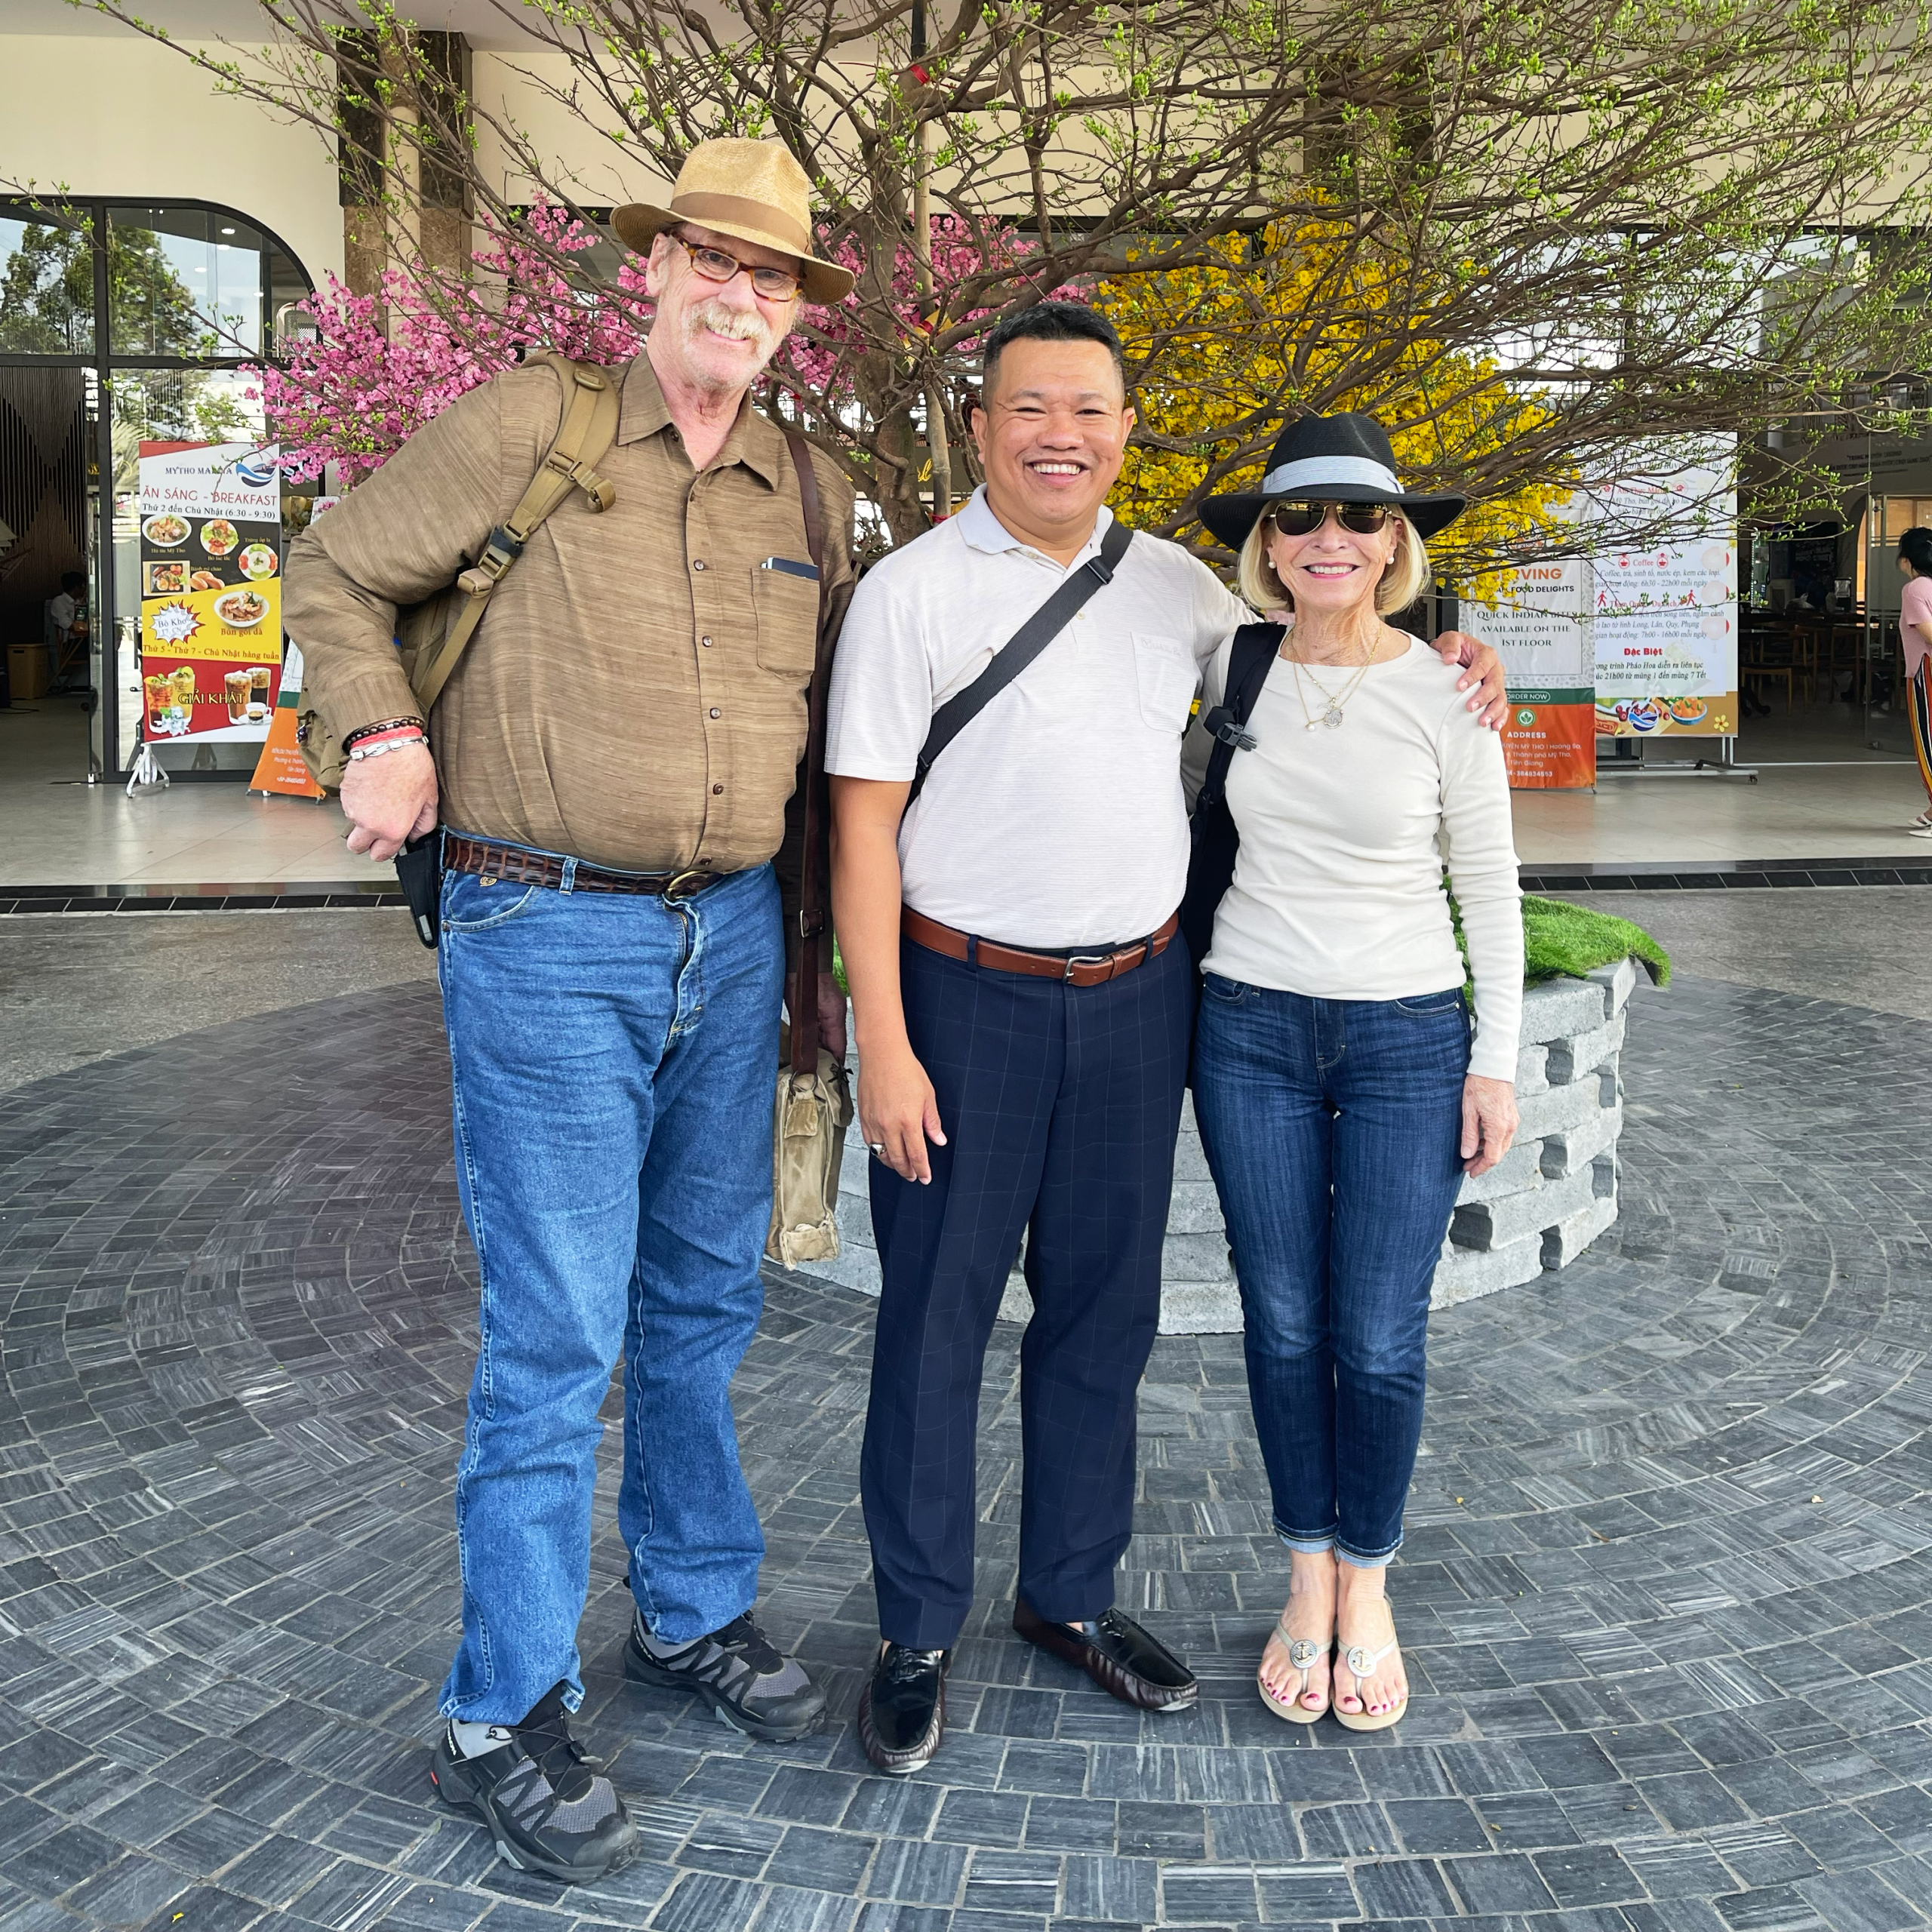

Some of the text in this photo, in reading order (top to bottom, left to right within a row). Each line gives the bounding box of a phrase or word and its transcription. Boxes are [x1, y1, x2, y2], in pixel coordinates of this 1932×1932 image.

[198, 466, 232, 475] MAA
[143, 485, 159, 498] ĂN
[165, 487, 198, 501] SÁNG
[214, 491, 277, 506] BREAKFAST
[143, 503, 158, 512] Thứ
[168, 503, 183, 513] đến
[186, 506, 202, 514] Chủ
[204, 507, 223, 517] Nhật
[226, 509, 246, 518] (6:30
[255, 510, 275, 520] 9:30)
[1494, 568, 1562, 580] VING
[1477, 611, 1509, 621] QUICK
[171, 617, 186, 626] Kho
[1633, 620, 1649, 630] Long,
[1481, 625, 1531, 633] AVAILABLE
[1534, 625, 1548, 633] ON
[143, 645, 158, 653] Thứ
[174, 646, 189, 654] Thứ
[204, 648, 220, 656] Chủ
[222, 649, 240, 658] Nhật
[243, 651, 260, 660] hàng
[263, 651, 279, 660] tuần
[1624, 648, 1663, 657] Đặc Biệt
[1634, 672, 1651, 681] mùng
[178, 688, 245, 705] GIẢI KHÁT
